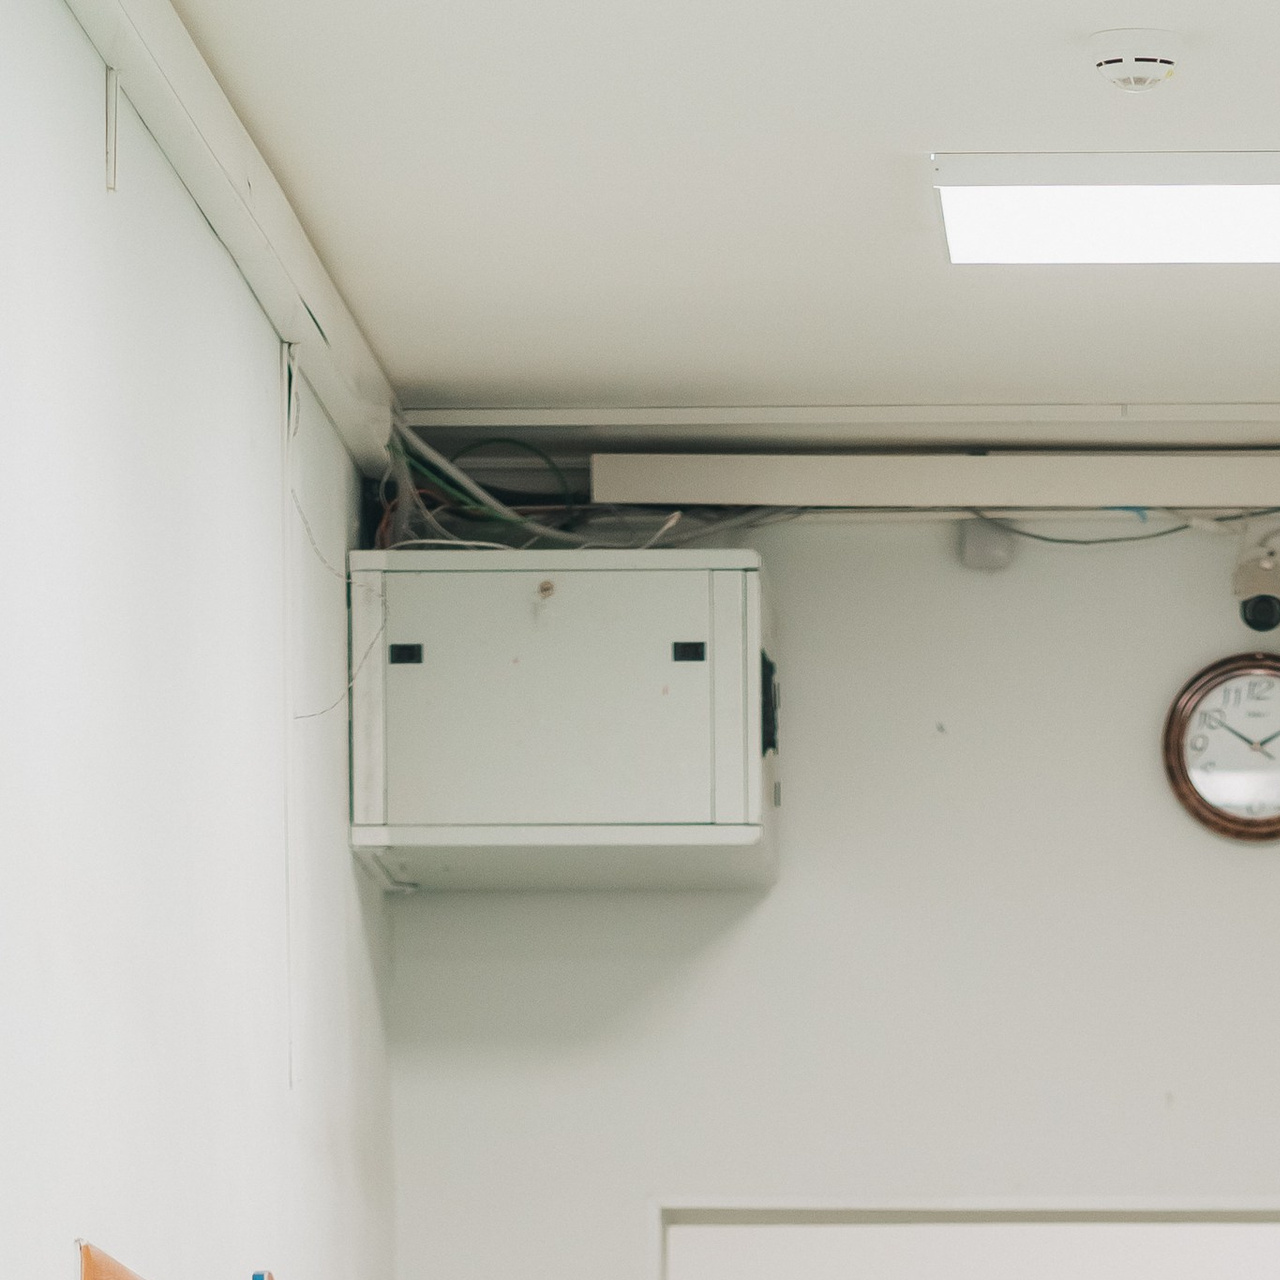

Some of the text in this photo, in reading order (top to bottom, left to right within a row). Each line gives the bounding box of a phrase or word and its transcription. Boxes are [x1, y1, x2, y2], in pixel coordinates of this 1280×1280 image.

[1221, 687, 1242, 708] 11
[1247, 679, 1275, 700] 12
[1198, 708, 1226, 730] 10
